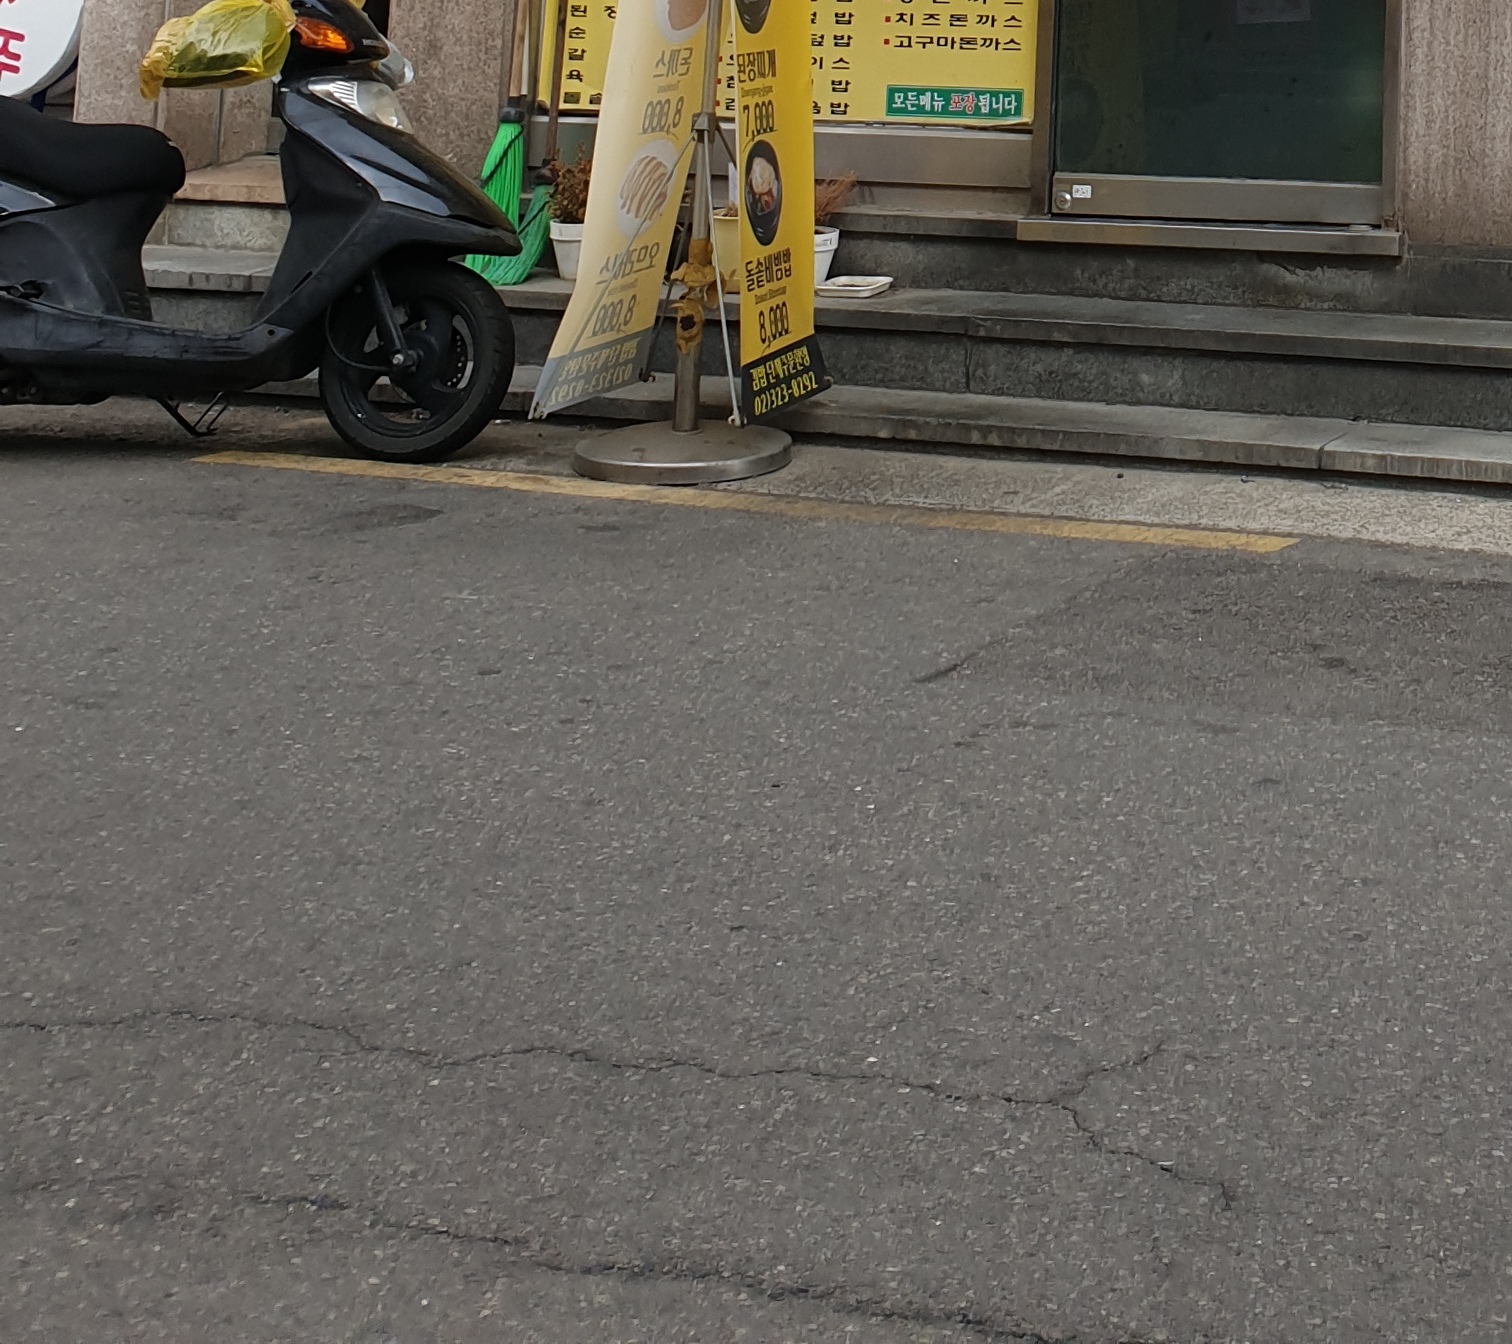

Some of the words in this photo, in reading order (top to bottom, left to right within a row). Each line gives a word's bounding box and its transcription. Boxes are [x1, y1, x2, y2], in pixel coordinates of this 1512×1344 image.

[894, 11, 1023, 29] 치즈돈까스
[892, 34, 1022, 51] 고구마돈까스
[737, 48, 777, 84] 된장찌개
[742, 98, 776, 139] 7,000
[892, 92, 946, 112] 모든메뉴
[744, 246, 793, 293] 돌솥비빔밥
[758, 299, 791, 347] 8,000
[750, 365, 768, 392] 김밥
[753, 370, 818, 416] 02)323-8292
